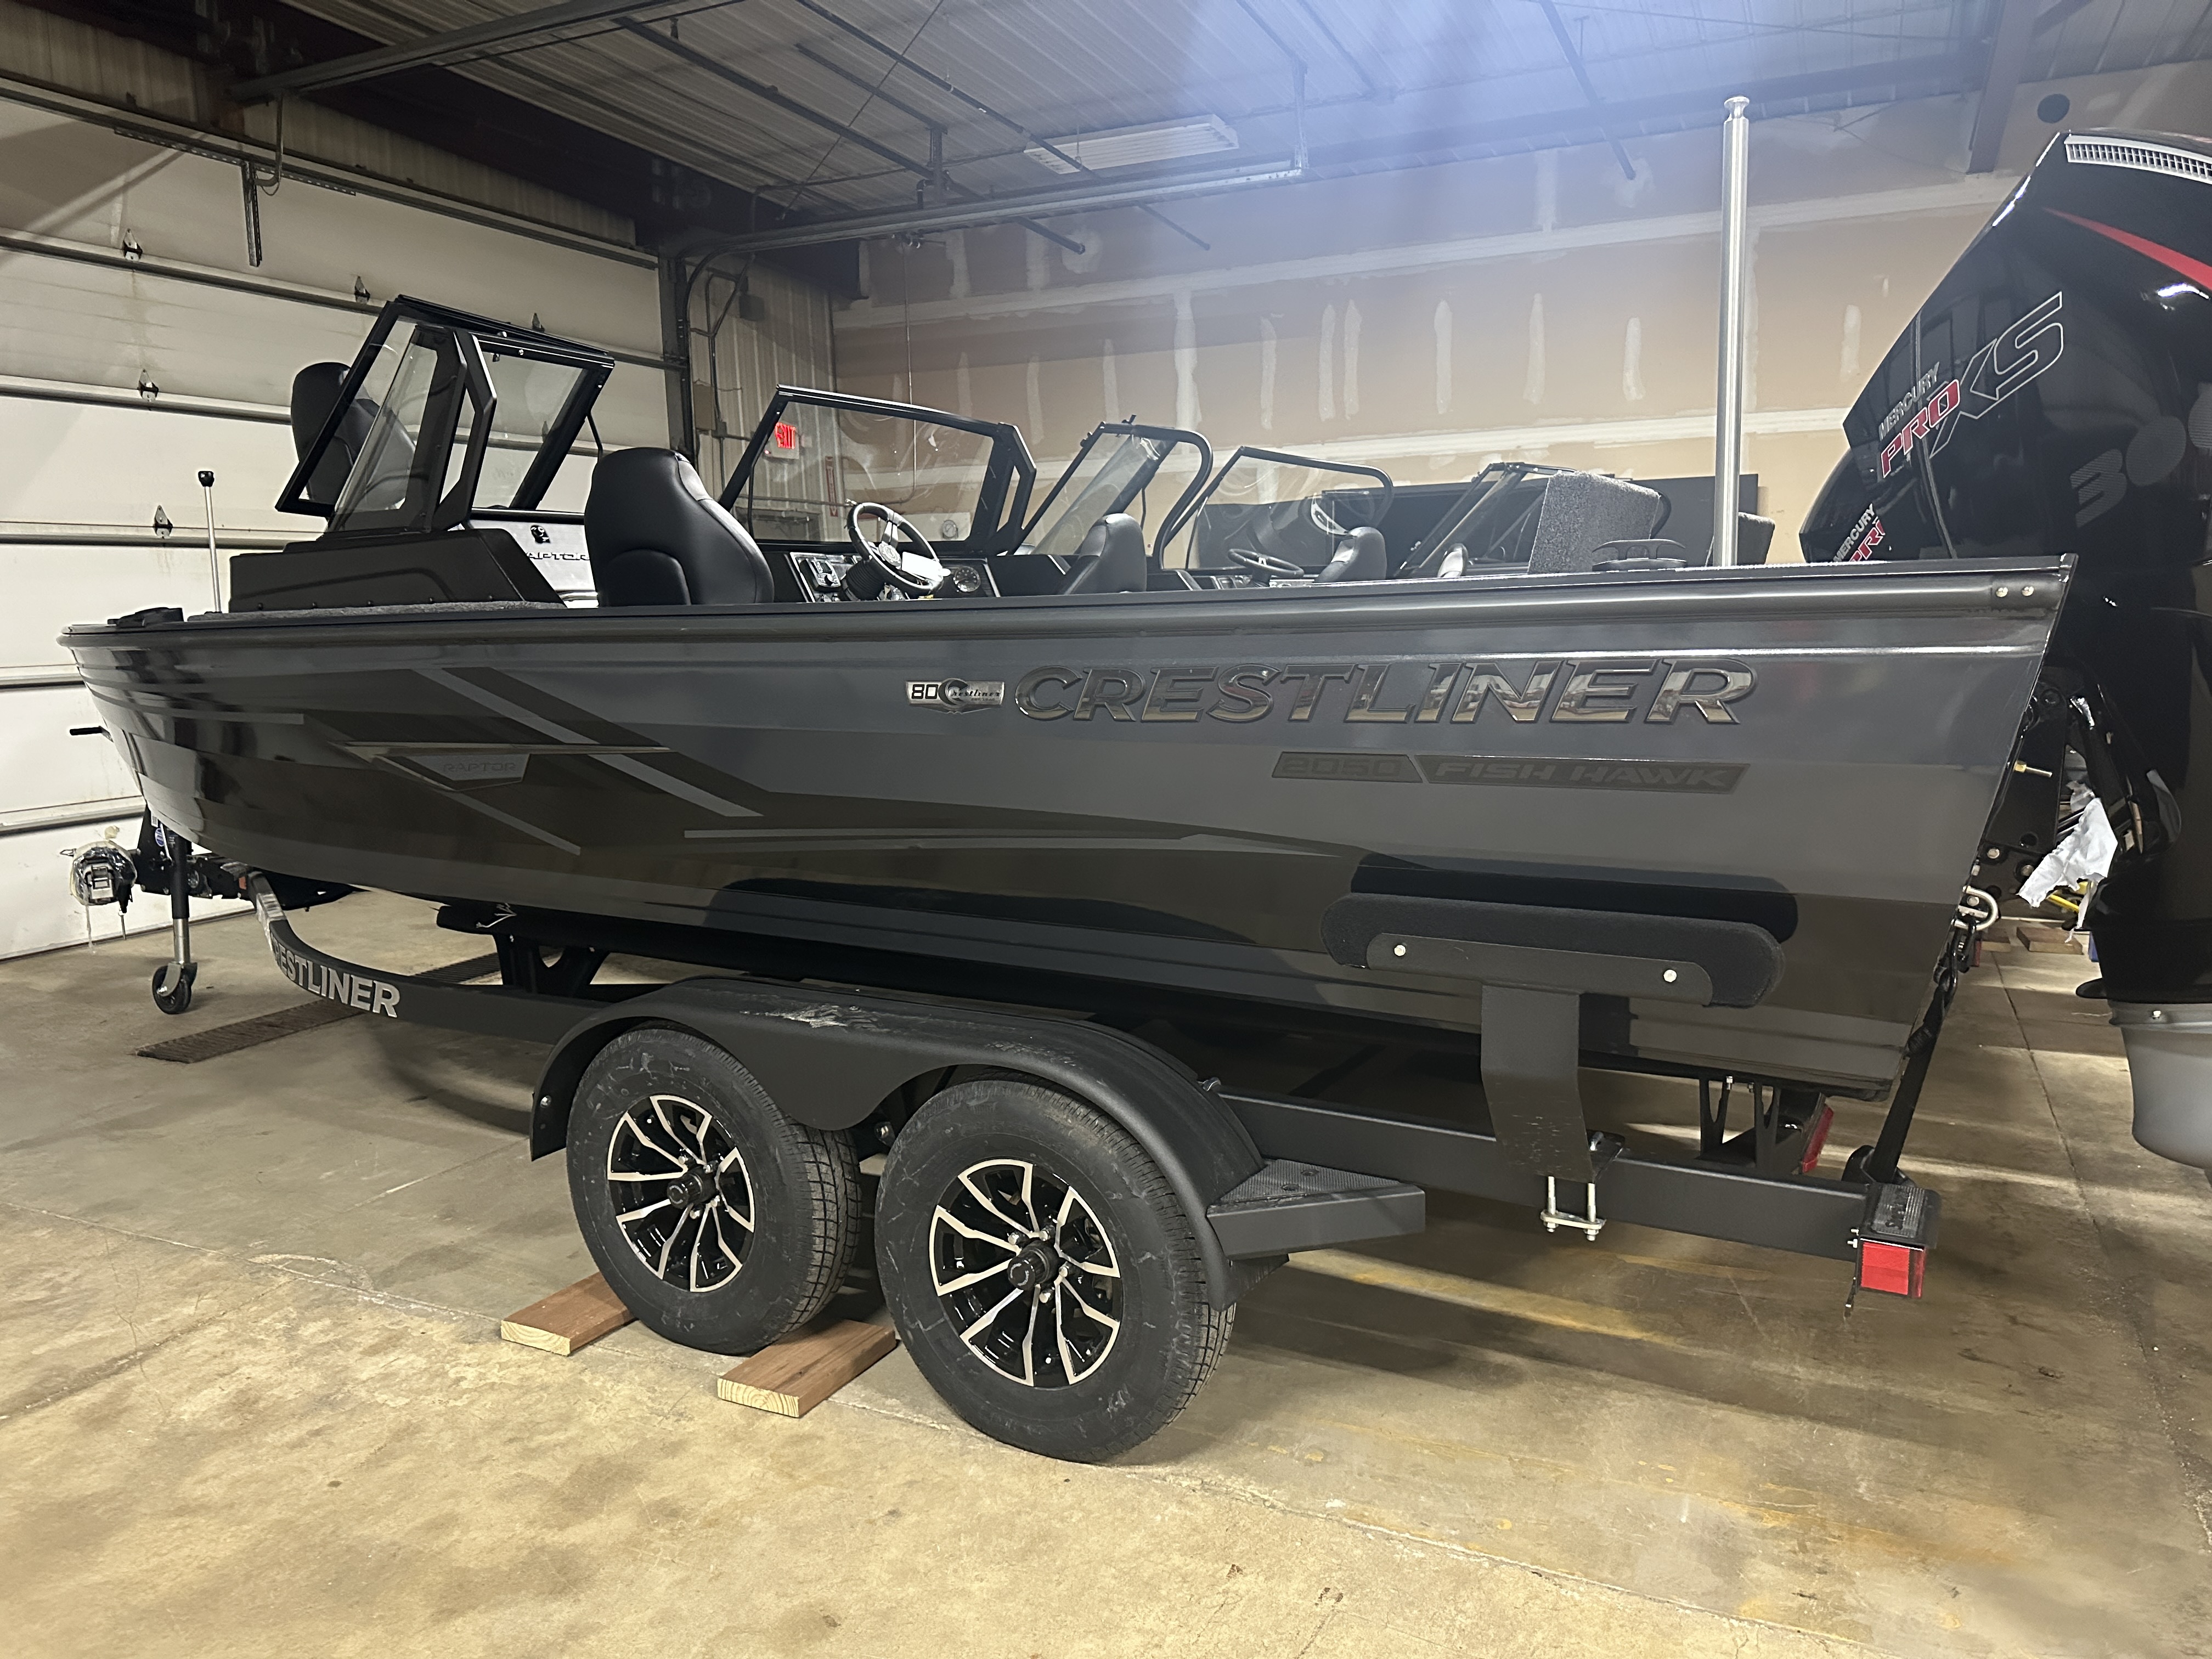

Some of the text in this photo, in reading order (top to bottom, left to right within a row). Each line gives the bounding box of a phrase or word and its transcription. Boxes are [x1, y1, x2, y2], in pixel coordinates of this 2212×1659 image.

[1878, 362, 1940, 441] MERCURY
[1880, 291, 2064, 478] PRO XS
[775, 422, 796, 450] EXIT
[1833, 503, 1875, 562] MERCURY
[911, 684, 939, 699] 80
[1014, 659, 1754, 723] CRESTLINER
[443, 762, 517, 773] RAPTOR
[1280, 757, 1730, 787] 2050 FISH HAWK
[271, 933, 400, 1018] RESTLINER
